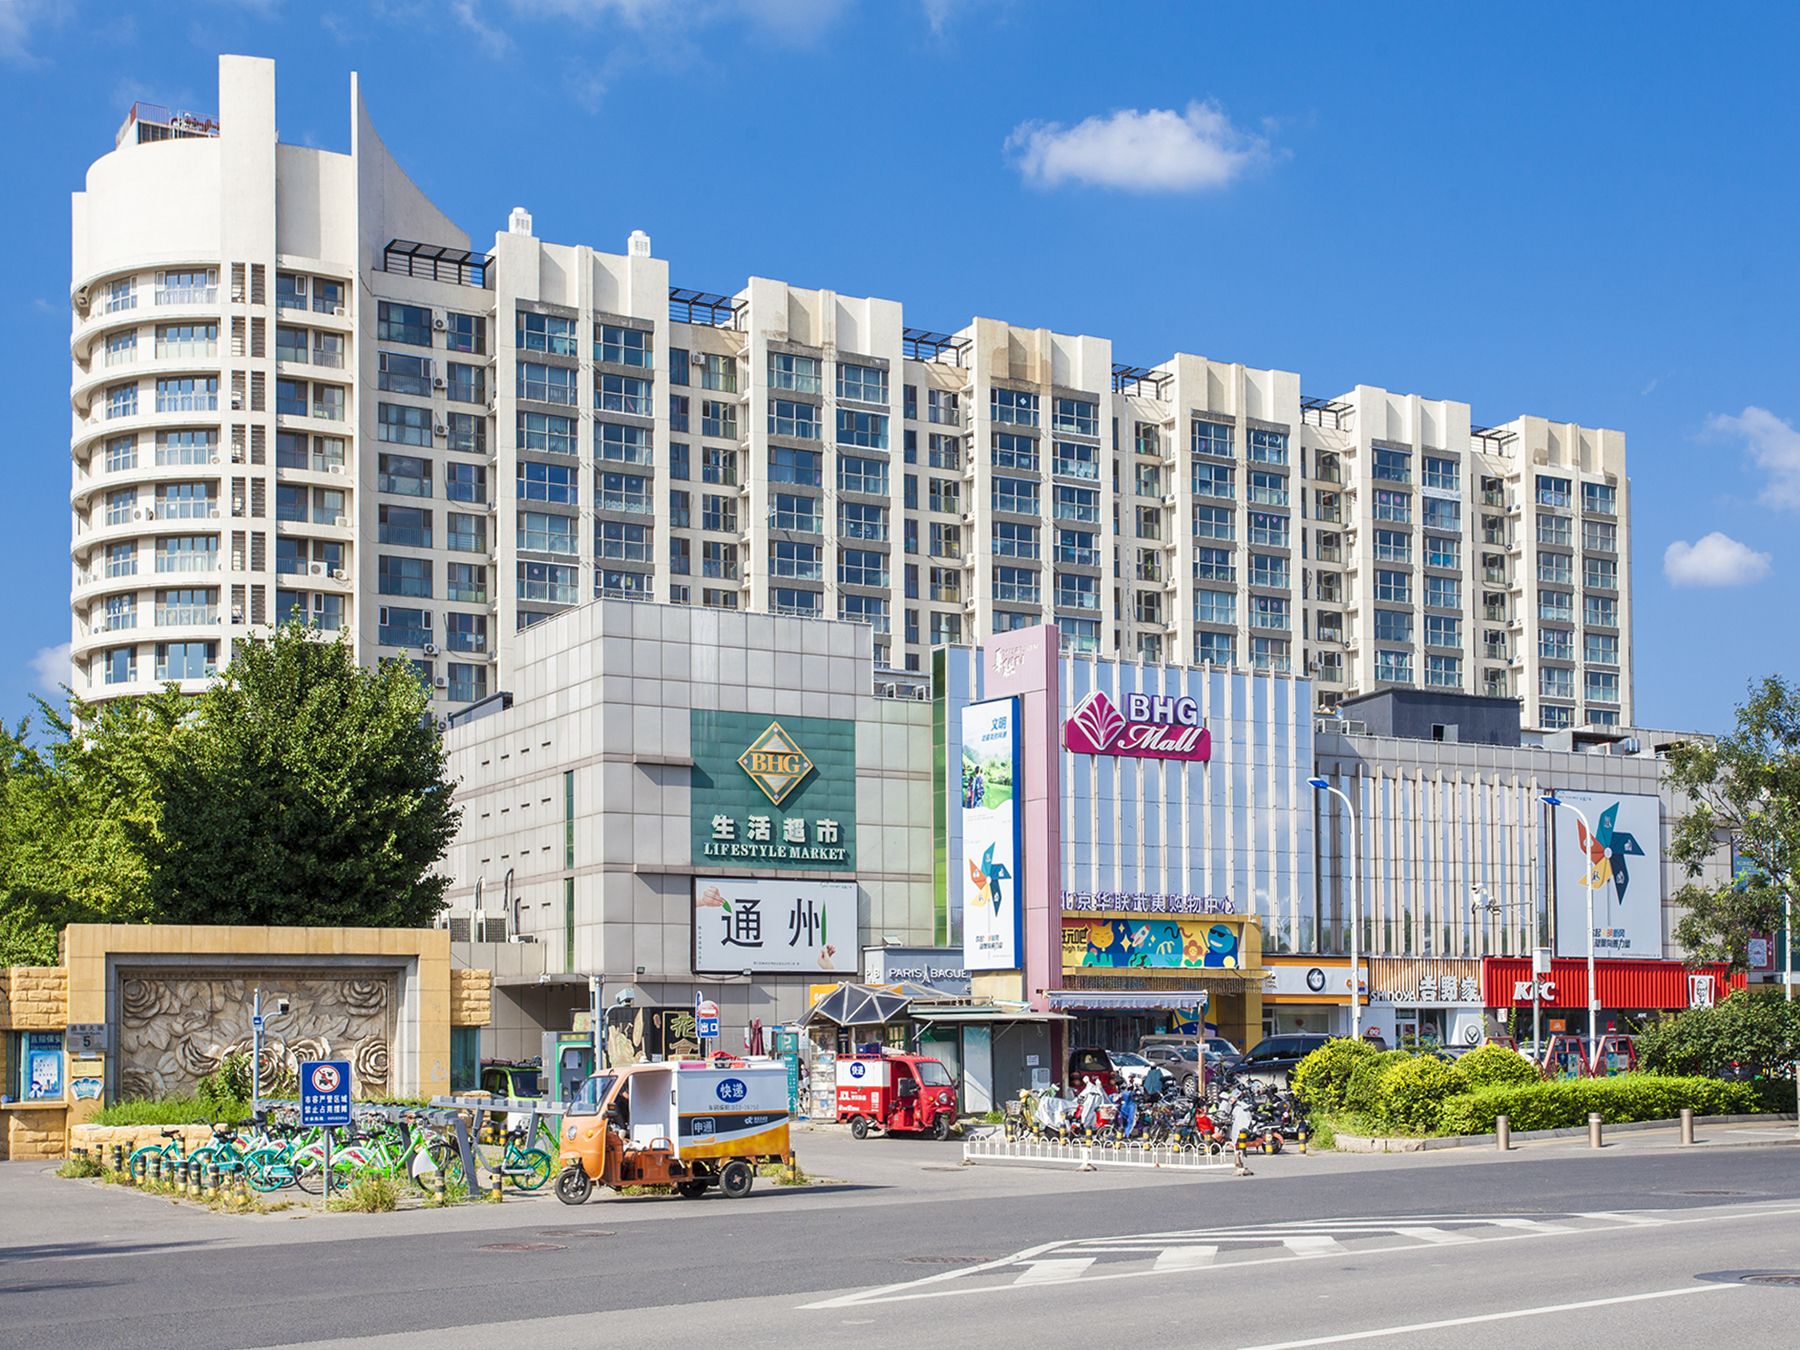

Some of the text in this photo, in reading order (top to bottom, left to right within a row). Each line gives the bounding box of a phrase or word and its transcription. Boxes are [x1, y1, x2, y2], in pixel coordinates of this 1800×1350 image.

[1128, 692, 1199, 726] BHG
[1117, 724, 1204, 753] Mall
[750, 752, 801, 773] BHG
[711, 814, 839, 843] 生活超市
[703, 842, 846, 860] LIFESTYLE MARKET
[1061, 890, 1236, 914] 北京华联武夷购物中心
[720, 897, 827, 948] 通州
[889, 968, 971, 979] PARIS BAGUE
[1419, 975, 1479, 1002] 吉野家
[1513, 981, 1556, 1001] KFC
[701, 1022, 718, 1032] 出口
[83, 1035, 91, 1047] 5
[720, 1083, 744, 1098] 快递
[694, 1121, 713, 1133] 申通
